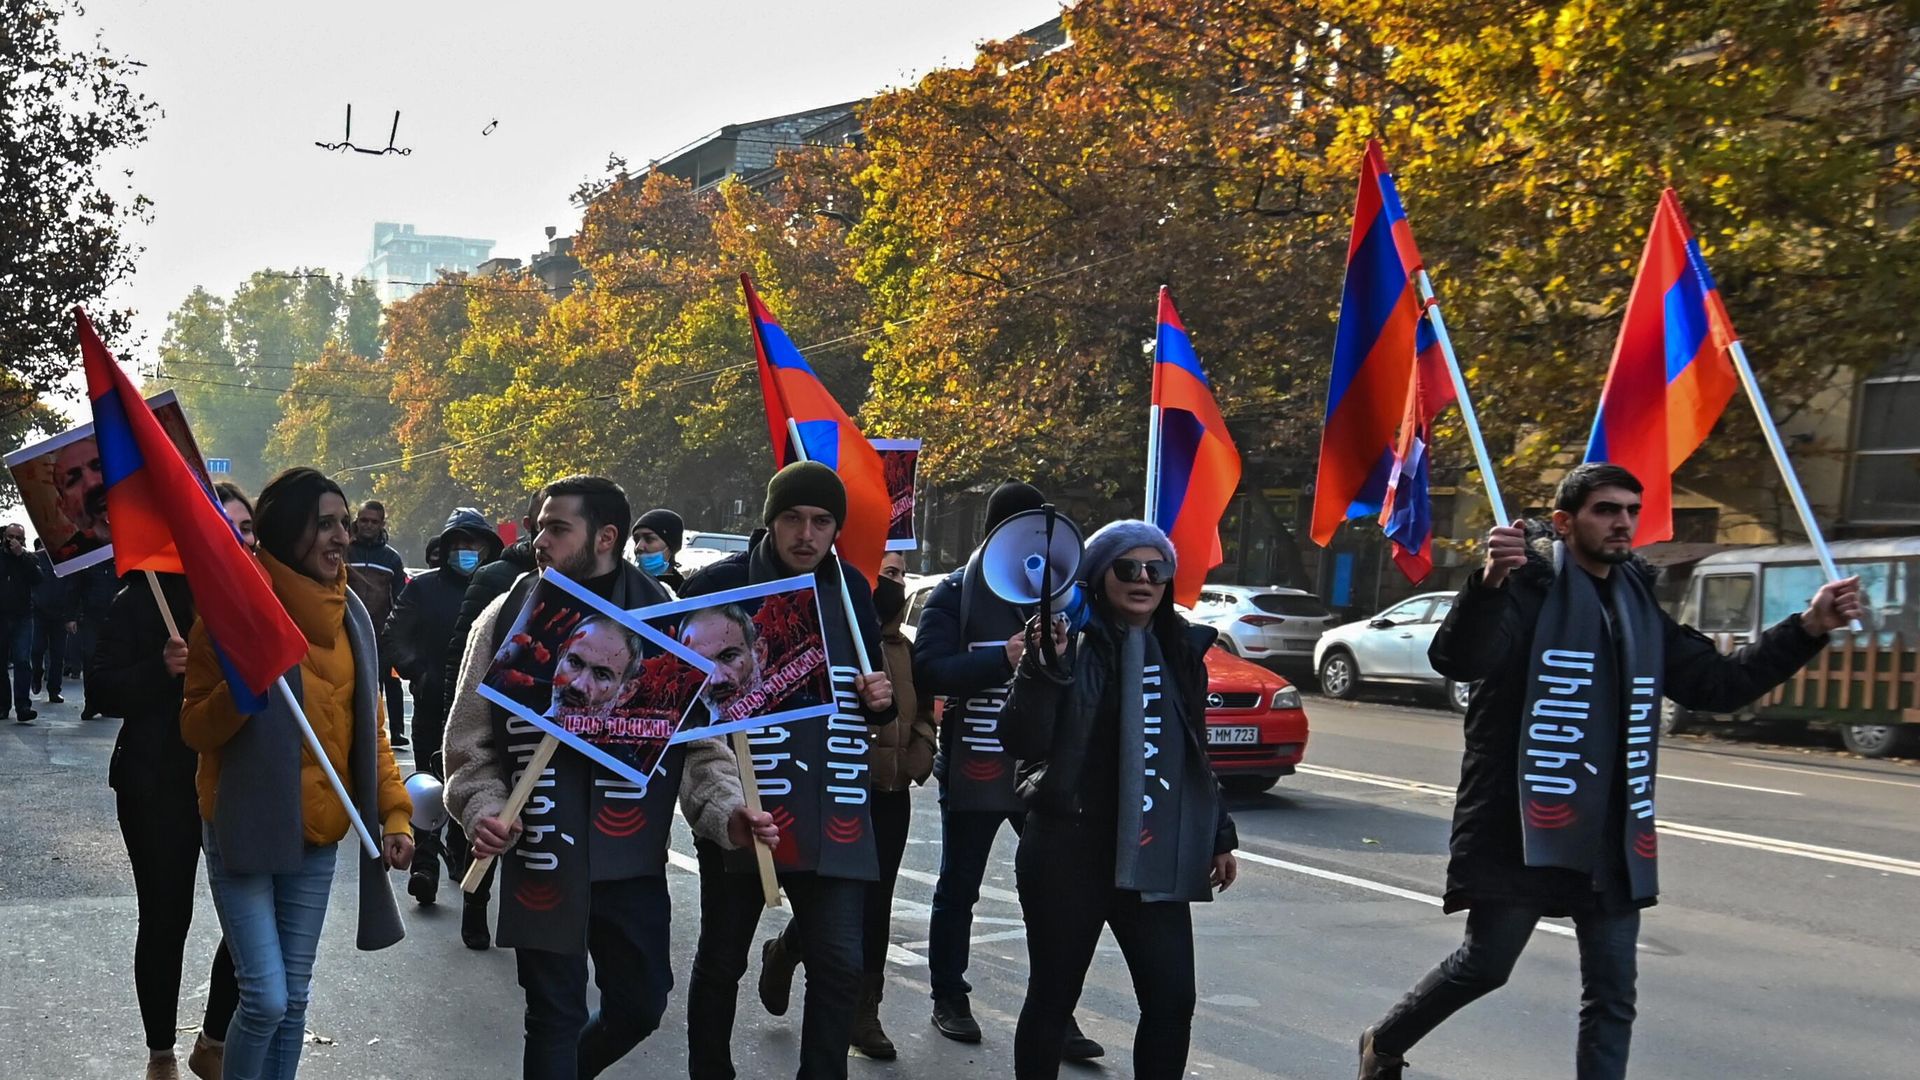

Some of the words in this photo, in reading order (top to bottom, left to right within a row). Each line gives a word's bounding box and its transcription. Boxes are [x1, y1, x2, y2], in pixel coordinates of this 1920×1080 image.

[1215, 729, 1232, 742] MM
[1234, 728, 1255, 742] 723
[1524, 649, 1597, 795] ՄԻԱՑԻ՛Ր
